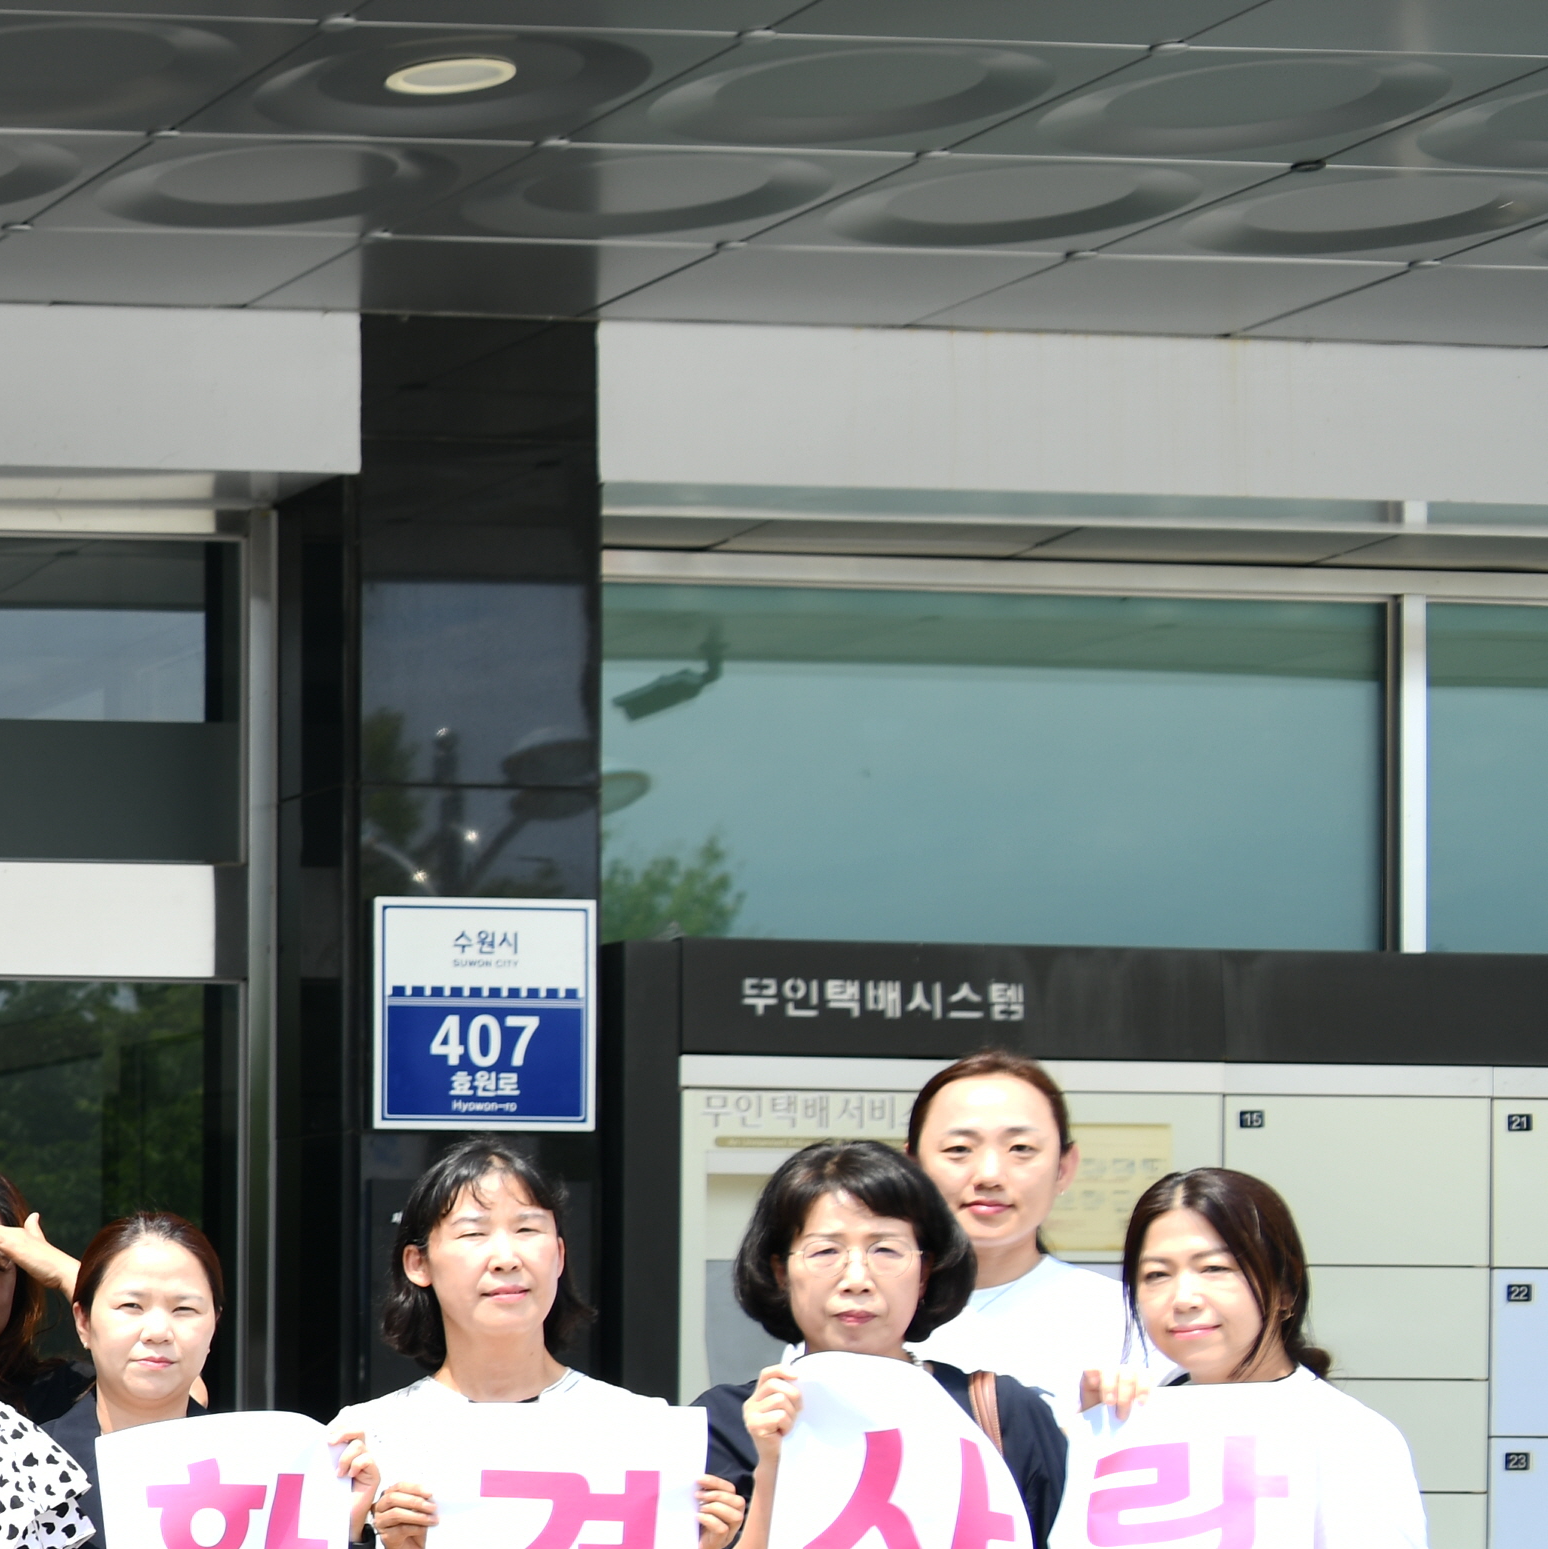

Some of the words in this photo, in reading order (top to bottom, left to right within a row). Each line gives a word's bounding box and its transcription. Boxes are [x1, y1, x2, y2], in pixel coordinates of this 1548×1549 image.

[453, 930, 519, 955] 수원시
[453, 958, 492, 968] SUWON
[496, 958, 519, 968] CITY
[741, 976, 1026, 1023] 무인택배시스템
[429, 1014, 540, 1067] 407
[449, 1070, 521, 1096] 효원로
[452, 1100, 517, 1113] Hyowon-ro
[1242, 1112, 1262, 1127] 15
[1511, 1115, 1528, 1130] 21
[1509, 1285, 1528, 1300] 22
[1508, 1454, 1527, 1469] 23
